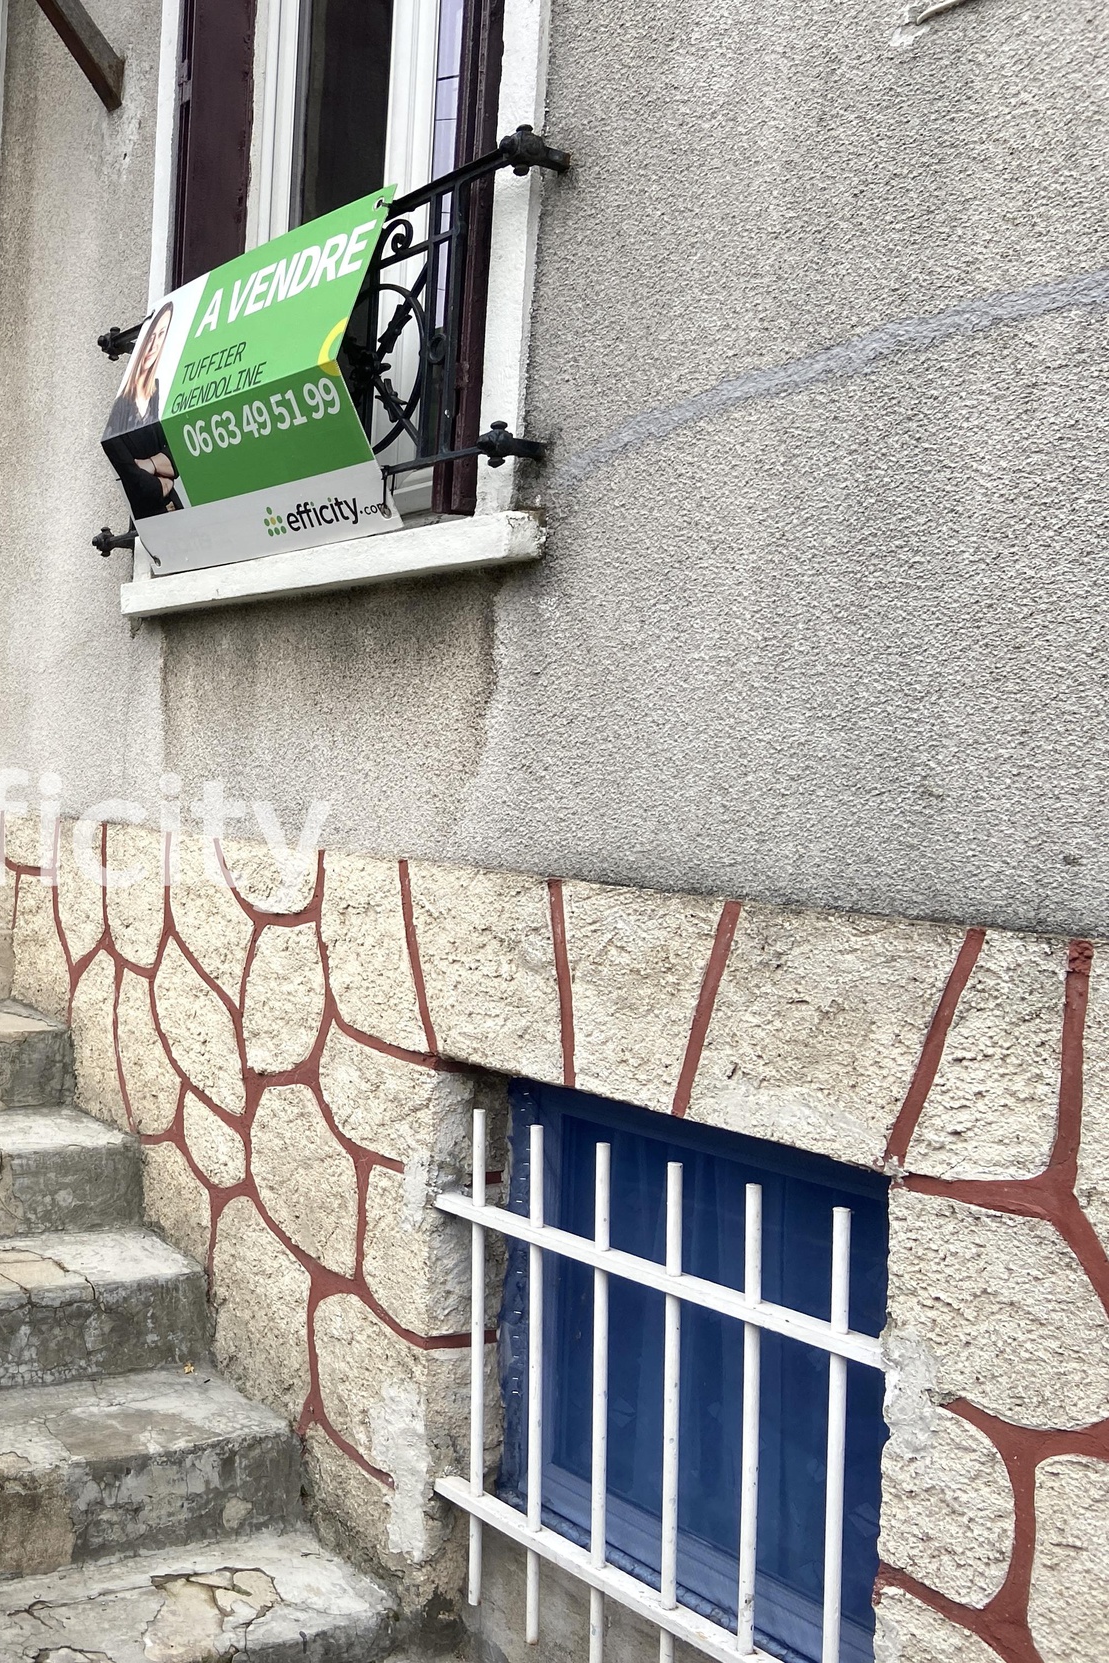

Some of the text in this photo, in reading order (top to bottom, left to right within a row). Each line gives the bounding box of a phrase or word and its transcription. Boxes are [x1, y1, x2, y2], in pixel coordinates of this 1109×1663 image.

[194, 219, 378, 339] A VENDRE
[171, 361, 267, 414] GWENDOLINE
[182, 341, 247, 384] TUFFIER
[183, 377, 341, 457] 06 63 49 51 99
